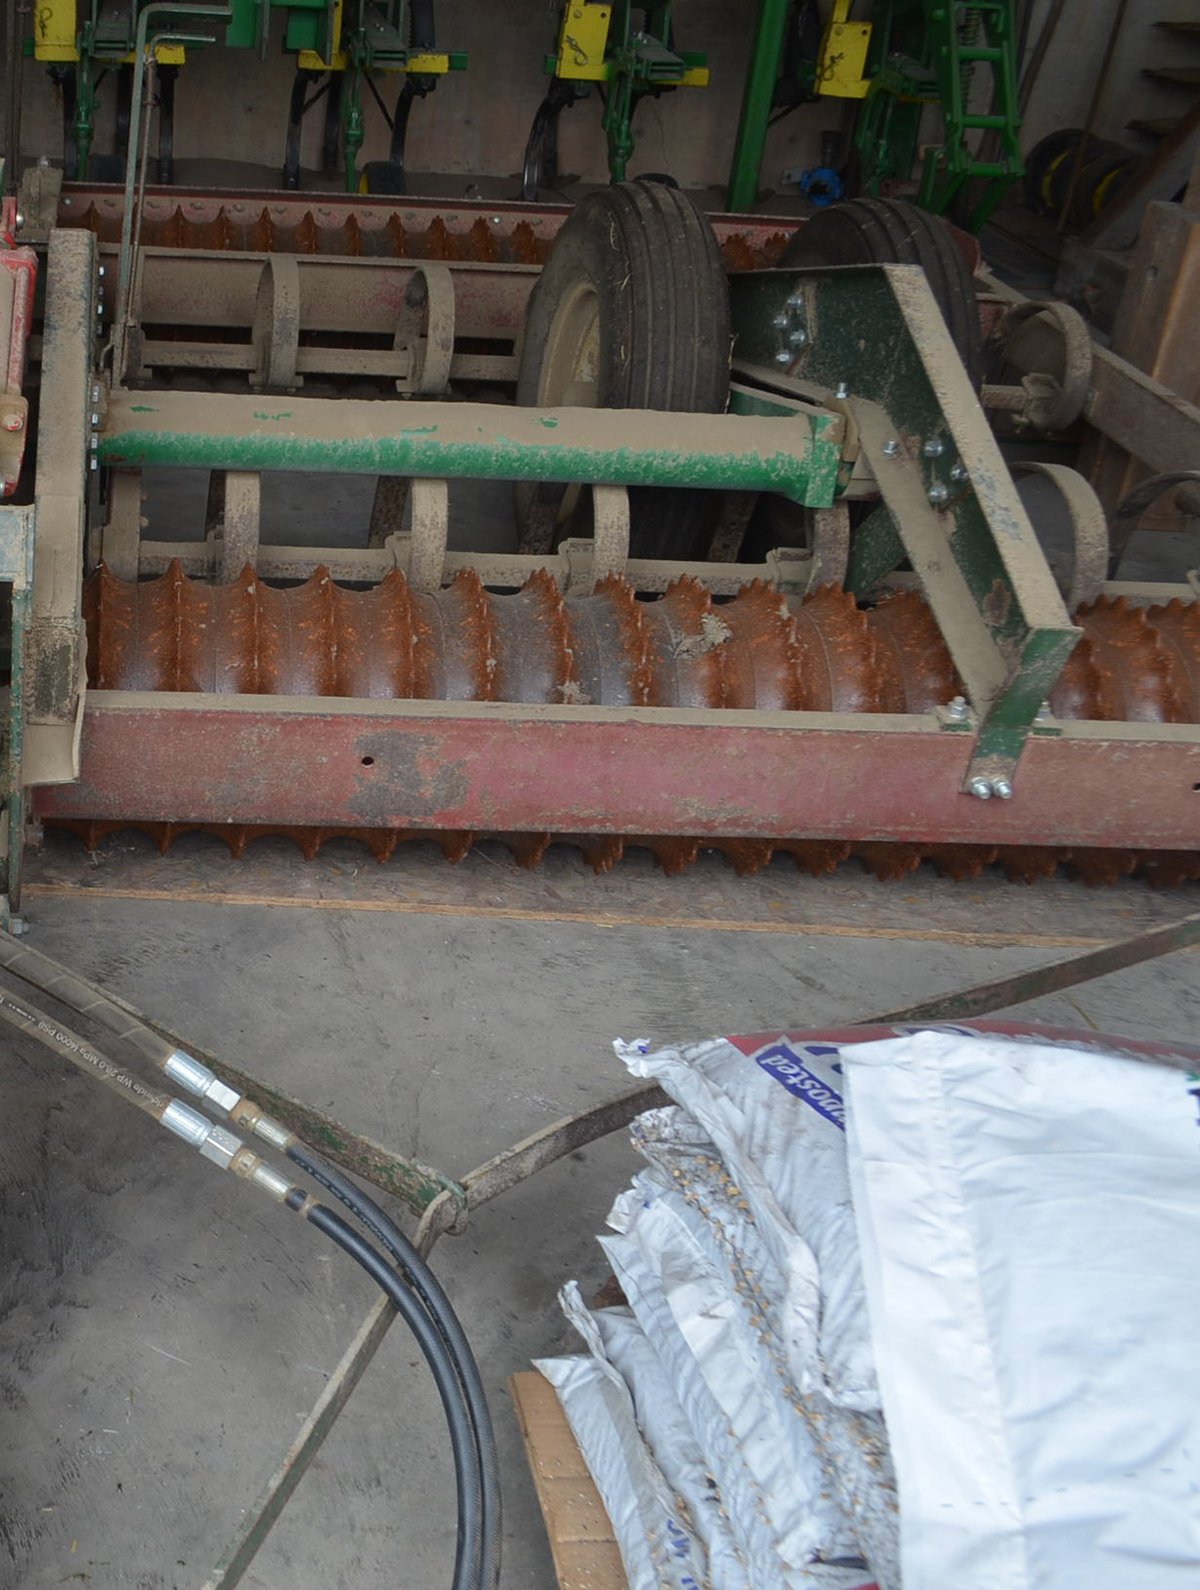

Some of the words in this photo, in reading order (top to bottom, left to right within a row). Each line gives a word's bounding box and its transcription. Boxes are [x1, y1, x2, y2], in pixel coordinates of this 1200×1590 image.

[38, 1021, 57, 1037] PSI)
[55, 1032, 79, 1052] (4000
[80, 1047, 99, 1065] MPa
[98, 1061, 118, 1077] 28.0
[116, 1075, 133, 1088] WP
